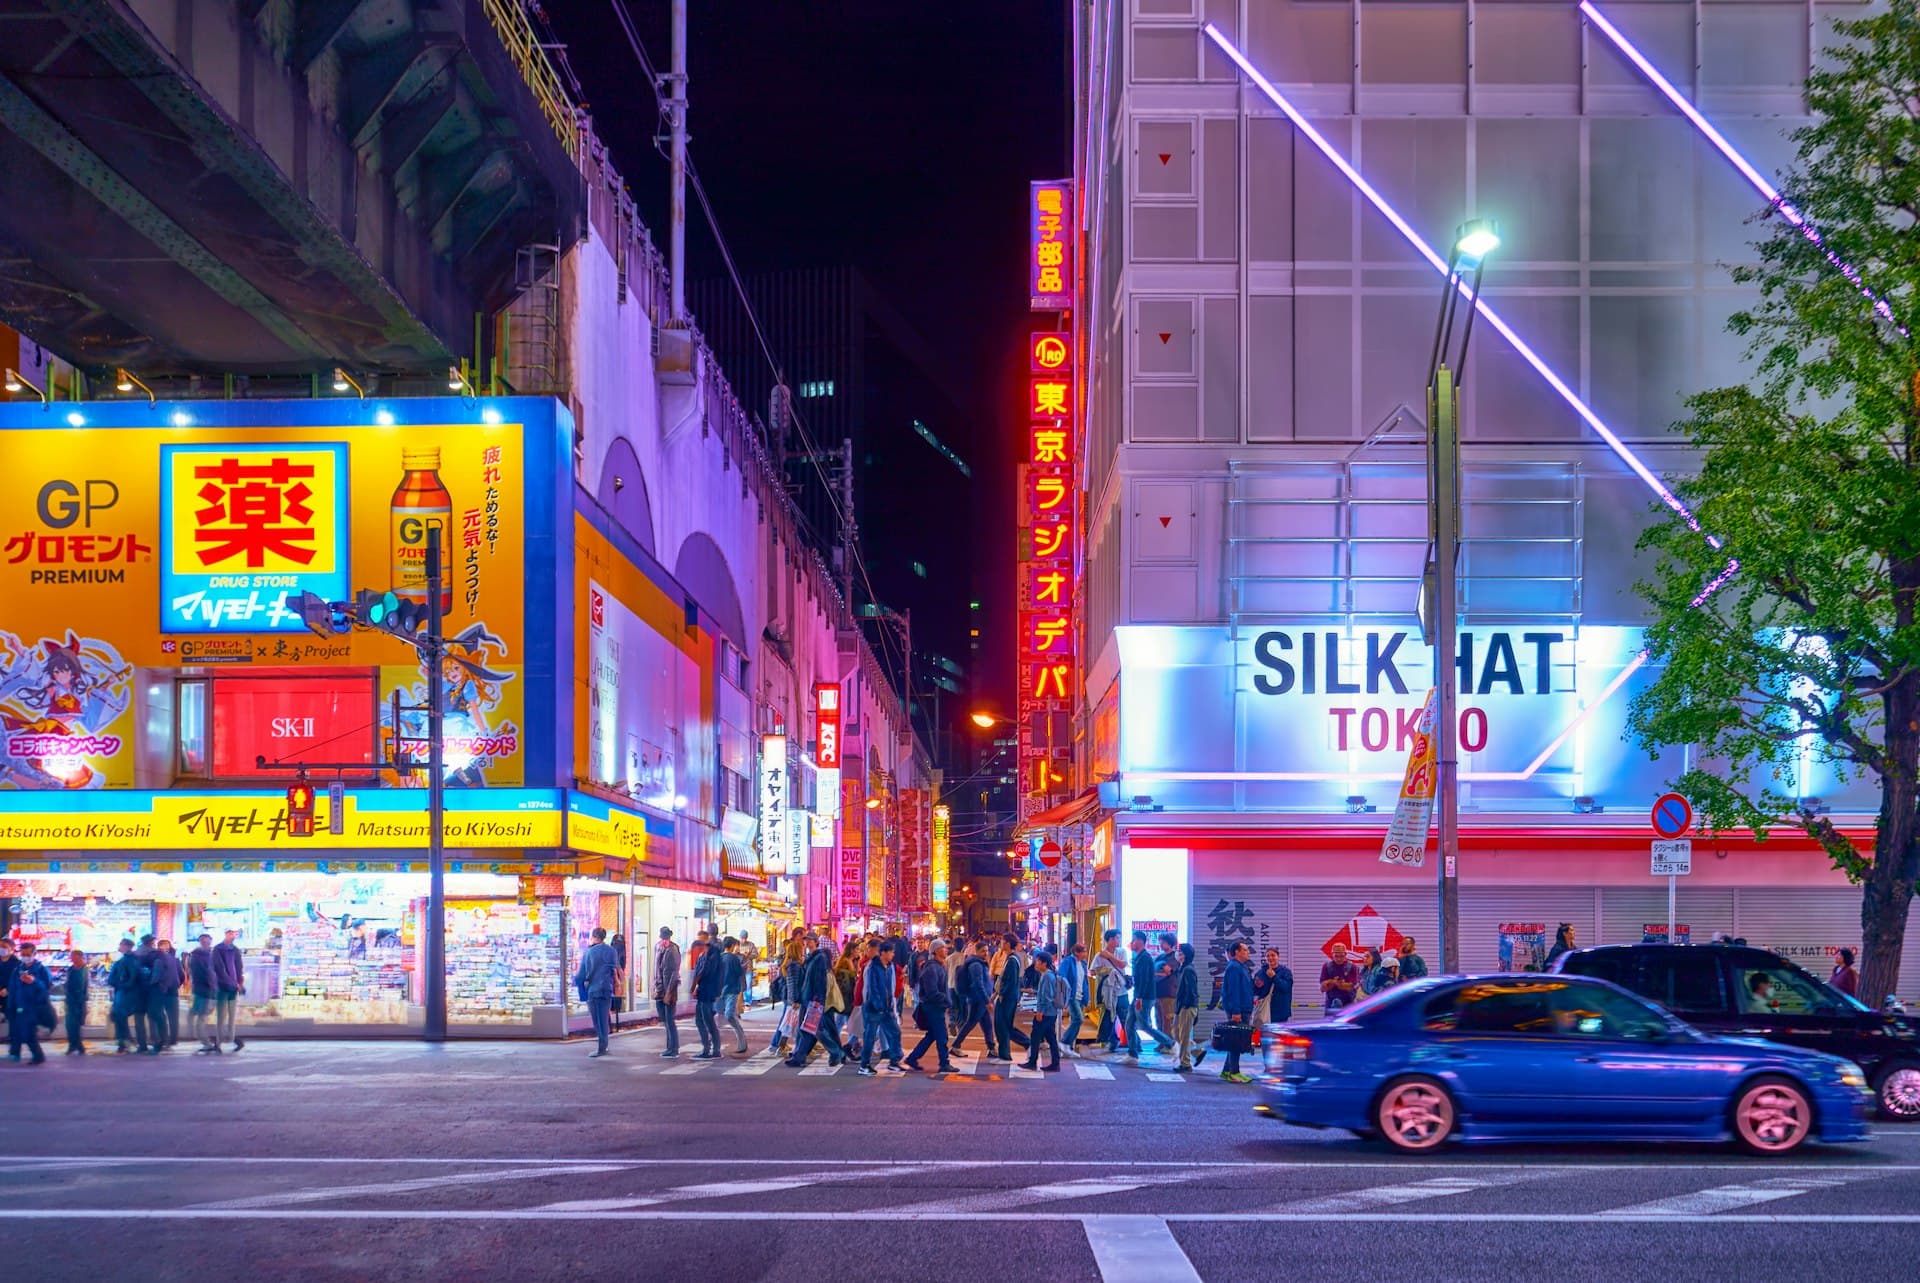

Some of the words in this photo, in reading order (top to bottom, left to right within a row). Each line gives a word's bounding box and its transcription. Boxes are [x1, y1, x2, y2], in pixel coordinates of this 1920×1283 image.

[1037, 189, 1062, 292] 電子部品
[37, 479, 119, 529] GP
[194, 458, 317, 567] 薬
[5, 531, 151, 564] グロモント
[31, 569, 124, 584] PREMIUM
[209, 576, 249, 588] DRUG
[253, 576, 298, 587] STORE
[1034, 383, 1067, 789] 東京ラジオデパート
[1254, 631, 1409, 695] SILK
[820, 722, 836, 762] KFC
[1329, 707, 1488, 752] TOKO
[85, 823, 151, 838] KiYoshi
[357, 823, 461, 837] Matsumto
[465, 822, 532, 837] KiYoshi
[1774, 947, 1798, 956] SILK
[1801, 947, 1821, 955] HAT
[1824, 946, 1858, 956] TOO
